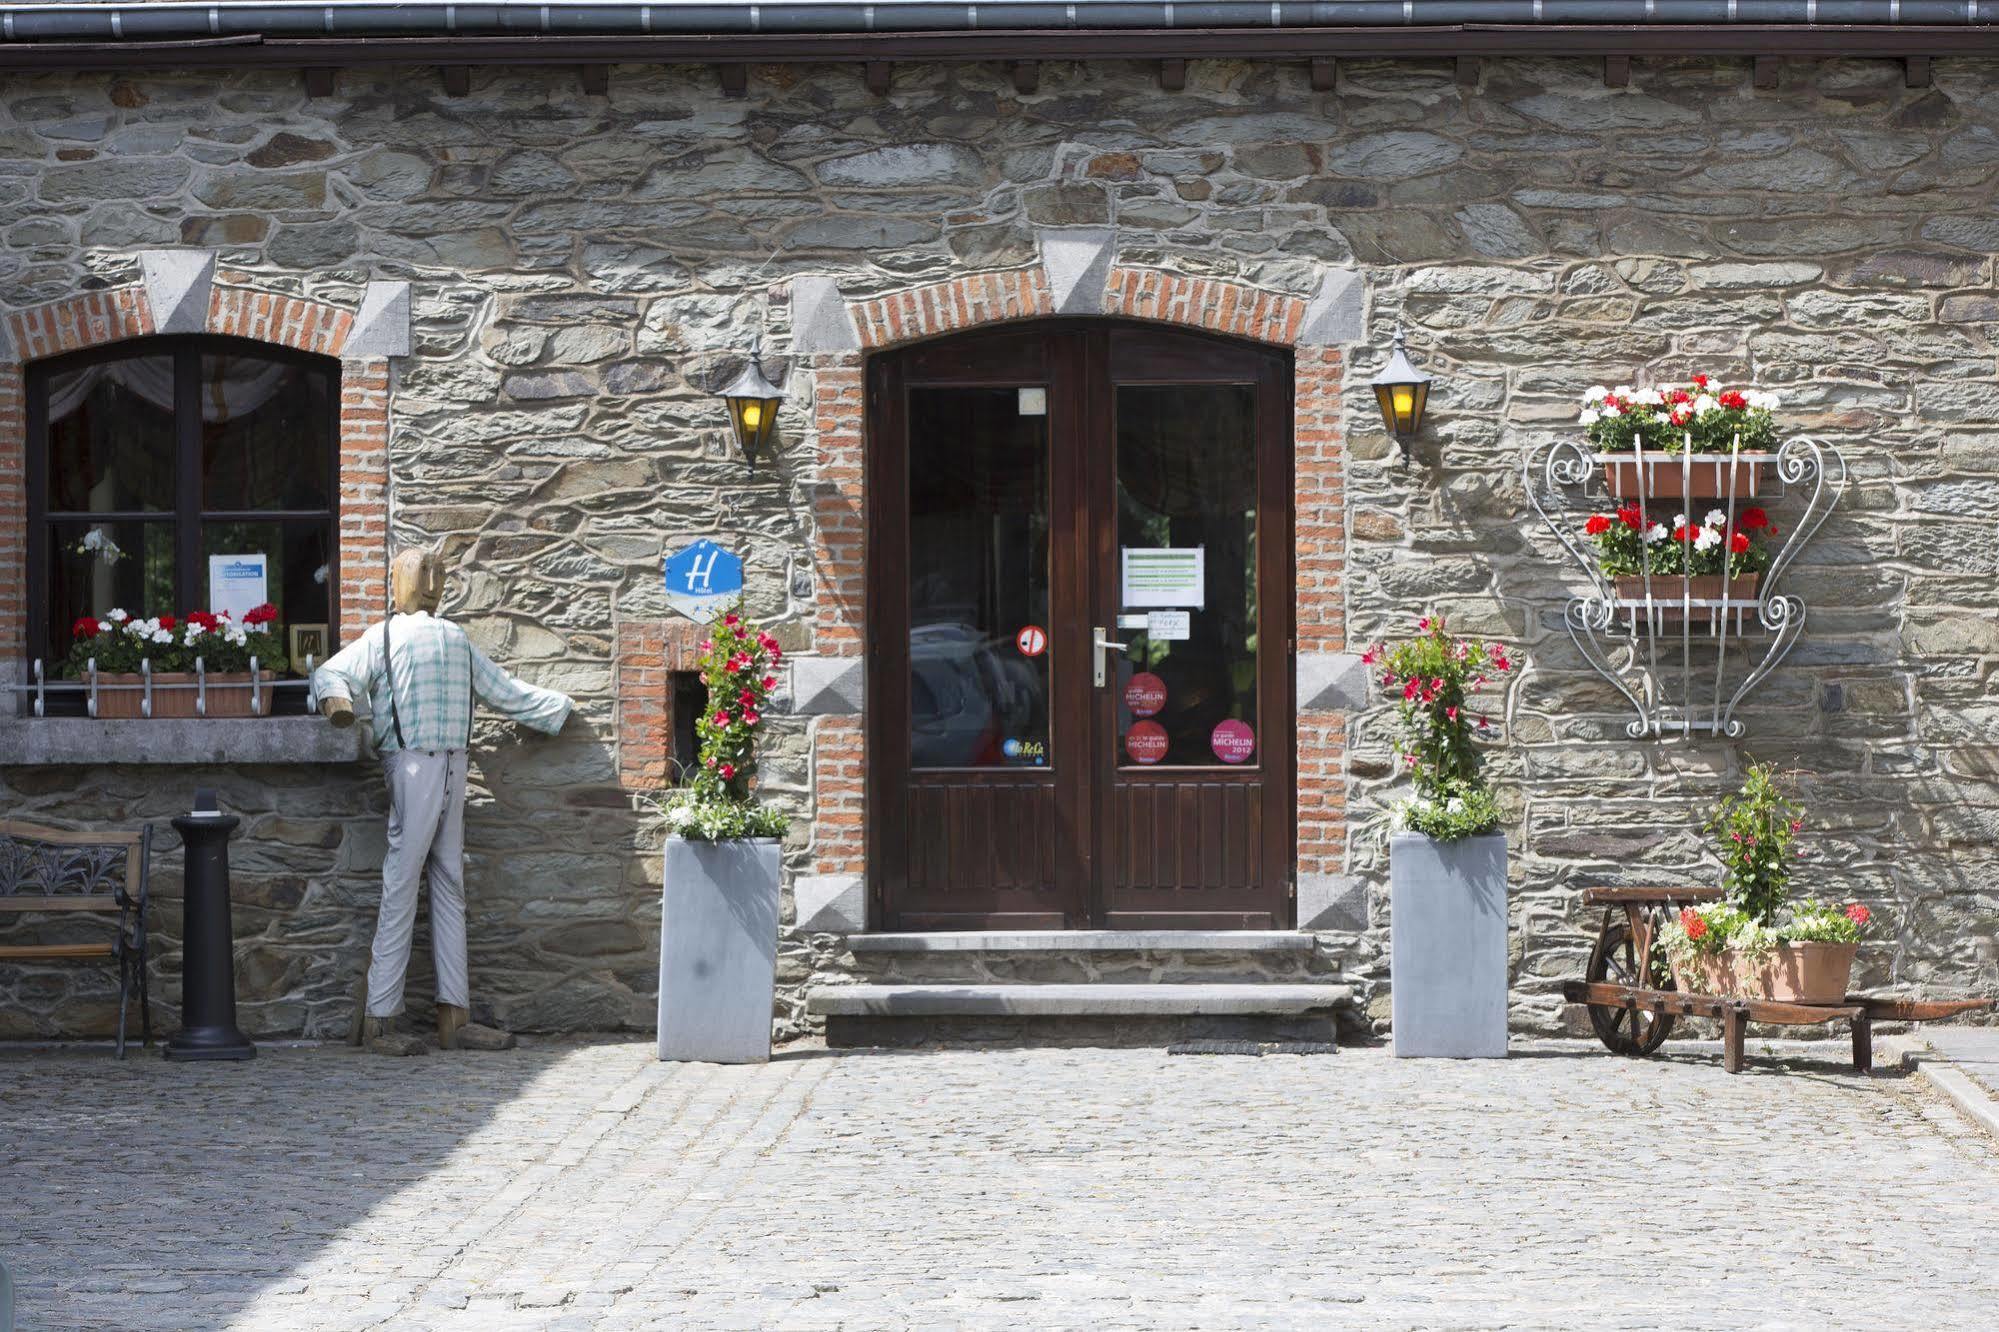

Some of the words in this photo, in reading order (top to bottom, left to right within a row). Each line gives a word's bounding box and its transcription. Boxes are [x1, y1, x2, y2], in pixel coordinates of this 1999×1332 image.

[685, 550, 719, 591] H
[1126, 693, 1164, 701] MICHELIN
[1128, 741, 1166, 749] MICHELIN
[1213, 738, 1253, 746] MICHELIN
[1231, 746, 1252, 754] 2012
